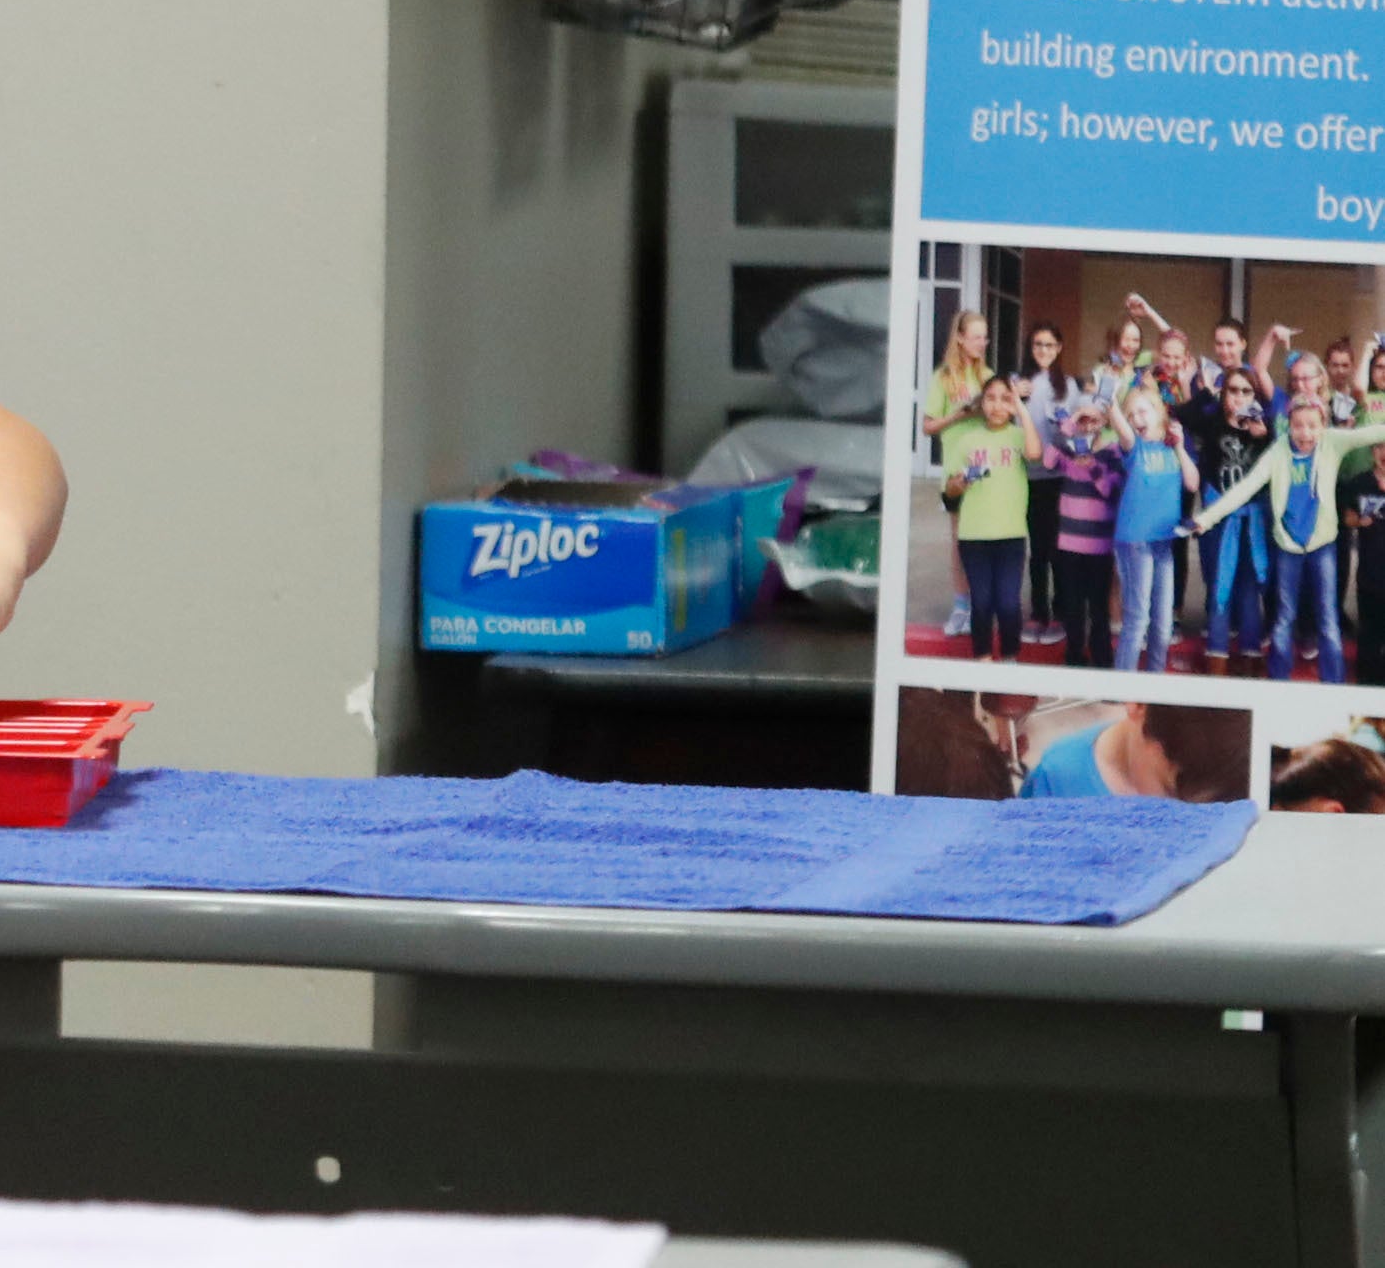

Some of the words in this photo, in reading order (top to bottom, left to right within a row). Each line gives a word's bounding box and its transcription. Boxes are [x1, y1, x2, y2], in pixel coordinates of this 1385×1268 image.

[980, 29, 1116, 78] building
[1125, 40, 1370, 83] environment.
[971, 100, 1049, 143] girls;
[1060, 102, 1218, 152] however,
[1231, 120, 1284, 148] we
[1295, 113, 1384, 152] offer
[469, 519, 601, 579] Ziploc
[430, 615, 479, 632] PARA
[484, 616, 587, 636] CONGELAR
